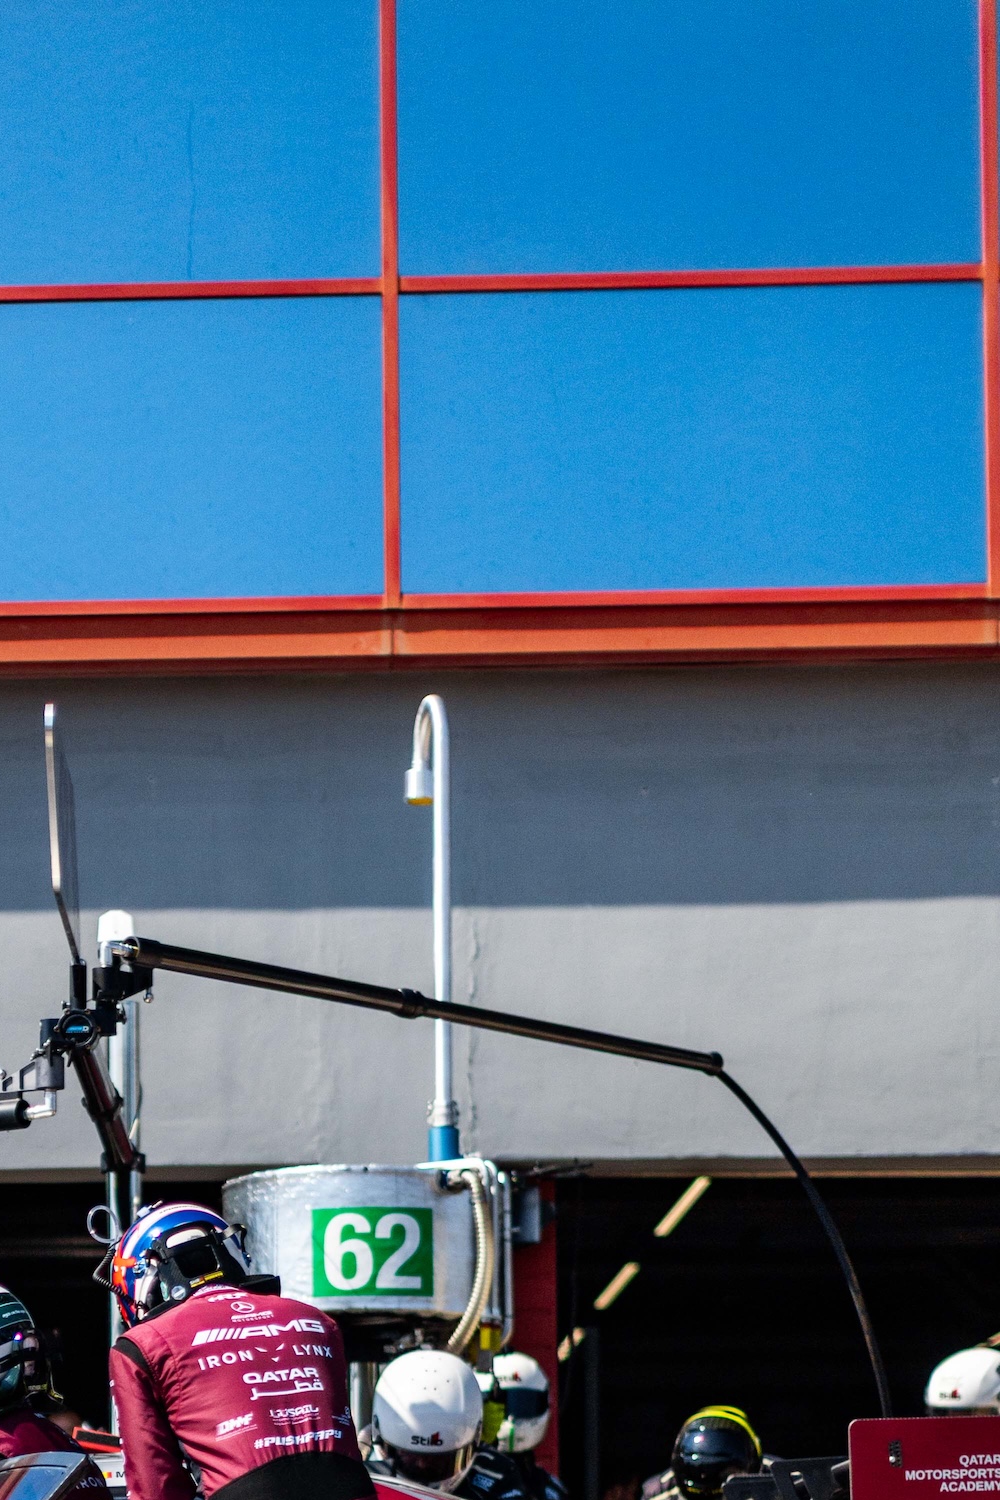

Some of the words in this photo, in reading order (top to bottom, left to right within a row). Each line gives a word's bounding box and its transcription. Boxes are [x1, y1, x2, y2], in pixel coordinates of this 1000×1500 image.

[324, 1212, 422, 1291] 62
[198, 1350, 253, 1370] IRON
[293, 1344, 332, 1358] LYNX
[243, 1367, 319, 1384] QATAR
[250, 1379, 324, 1401] قطر
[959, 1454, 1000, 1467] QATAR
[905, 1468, 1000, 1481] MOTORSPORTS
[940, 1481, 1000, 1492] ACADEMY
